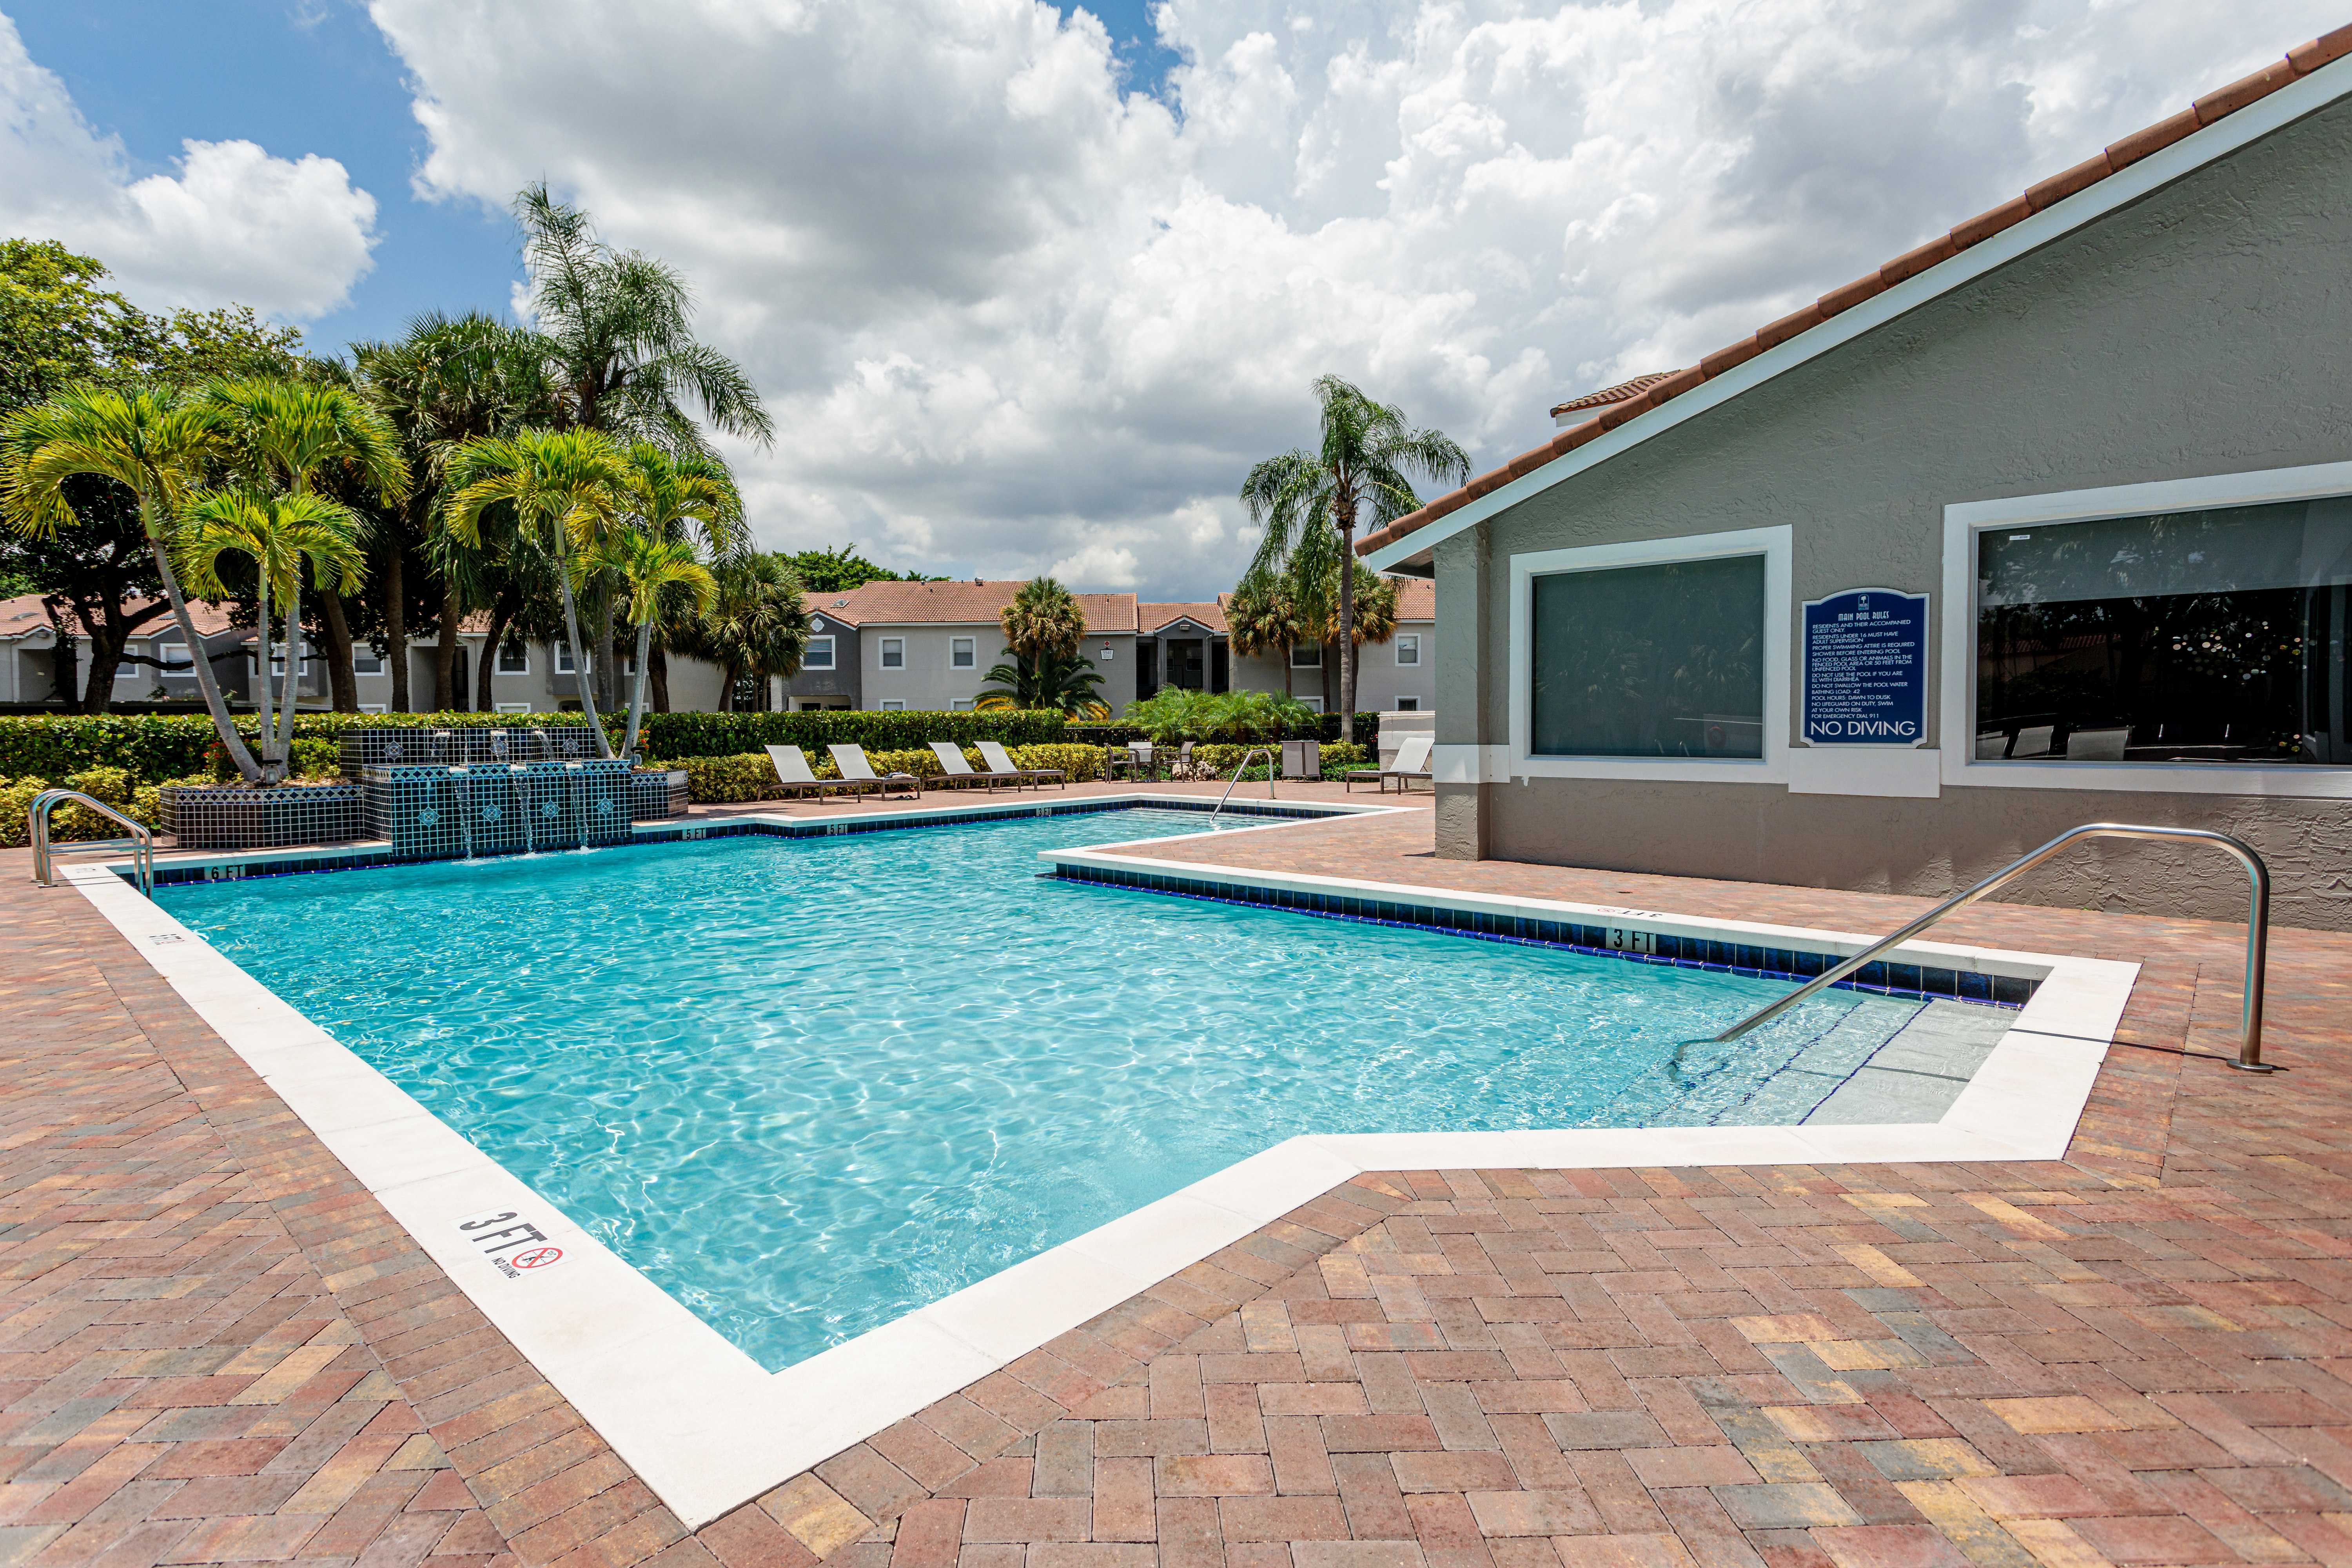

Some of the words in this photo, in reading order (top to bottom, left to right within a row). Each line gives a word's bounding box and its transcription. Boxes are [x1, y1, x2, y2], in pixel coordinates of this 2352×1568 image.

[1811, 721, 1842, 735] NO
[1848, 721, 1915, 735] DIVING
[687, 829, 691, 839] 5
[695, 828, 705, 839] FT
[830, 824, 834, 834] 5
[838, 824, 847, 834] FT
[212, 867, 219, 879] 6
[226, 865, 243, 878] FT
[1614, 929, 1623, 947] 3
[1632, 931, 1654, 952] FT
[460, 1212, 517, 1230] 3
[472, 1223, 548, 1254] FT
[499, 1263, 520, 1278] DIVING
